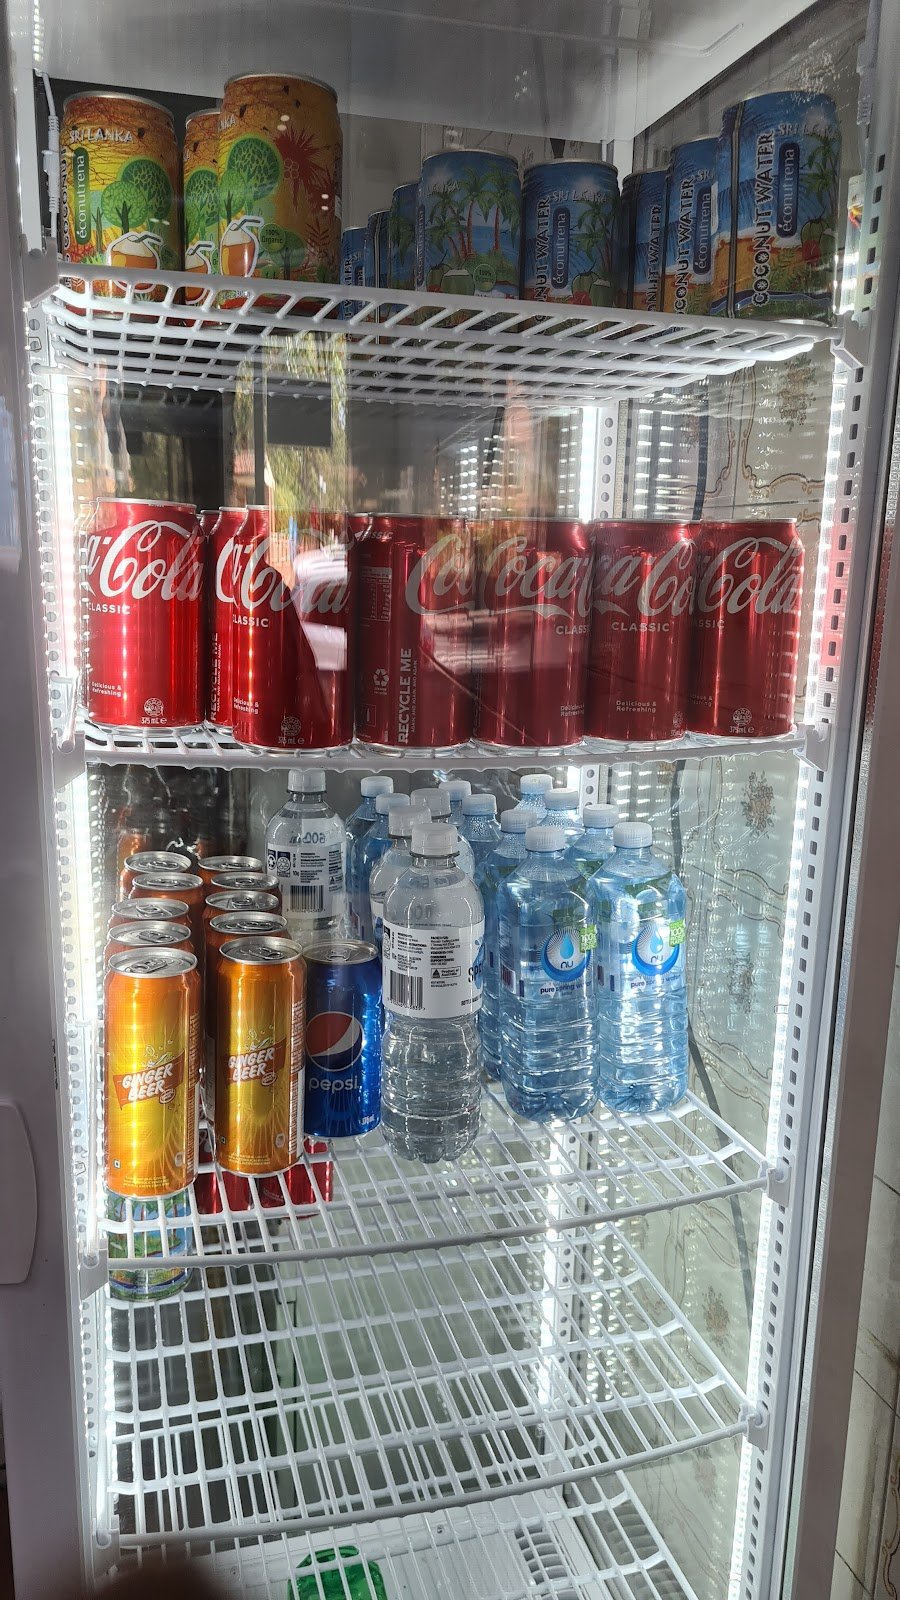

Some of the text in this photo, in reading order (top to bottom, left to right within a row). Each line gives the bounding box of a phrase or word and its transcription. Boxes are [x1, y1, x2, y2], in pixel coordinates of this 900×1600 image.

[69, 128, 133, 143] SRI LANKA
[76, 155, 87, 239] éconutrena
[777, 149, 795, 232] éconutrena
[752, 128, 775, 307] COCONUT WATER
[536, 197, 551, 261] WATER
[694, 193, 711, 269] éconutrena
[554, 213, 566, 284] éconutrena
[674, 174, 696, 315] CONUT WATER
[611, 621, 670, 633] CLASSIC
[397, 648, 412, 744] RECYCLE ME
[615, 705, 657, 714] Refreshing
[560, 961, 574, 969] nu
[540, 986, 555, 994] pure
[555, 983, 575, 993] spring
[630, 980, 645, 989] pure
[228, 1047, 275, 1068] GINGER
[122, 1063, 173, 1089] GINGER
[232, 1063, 267, 1082] BEER
[128, 1080, 166, 1102] BEER
[308, 1075, 359, 1095] pepsi
